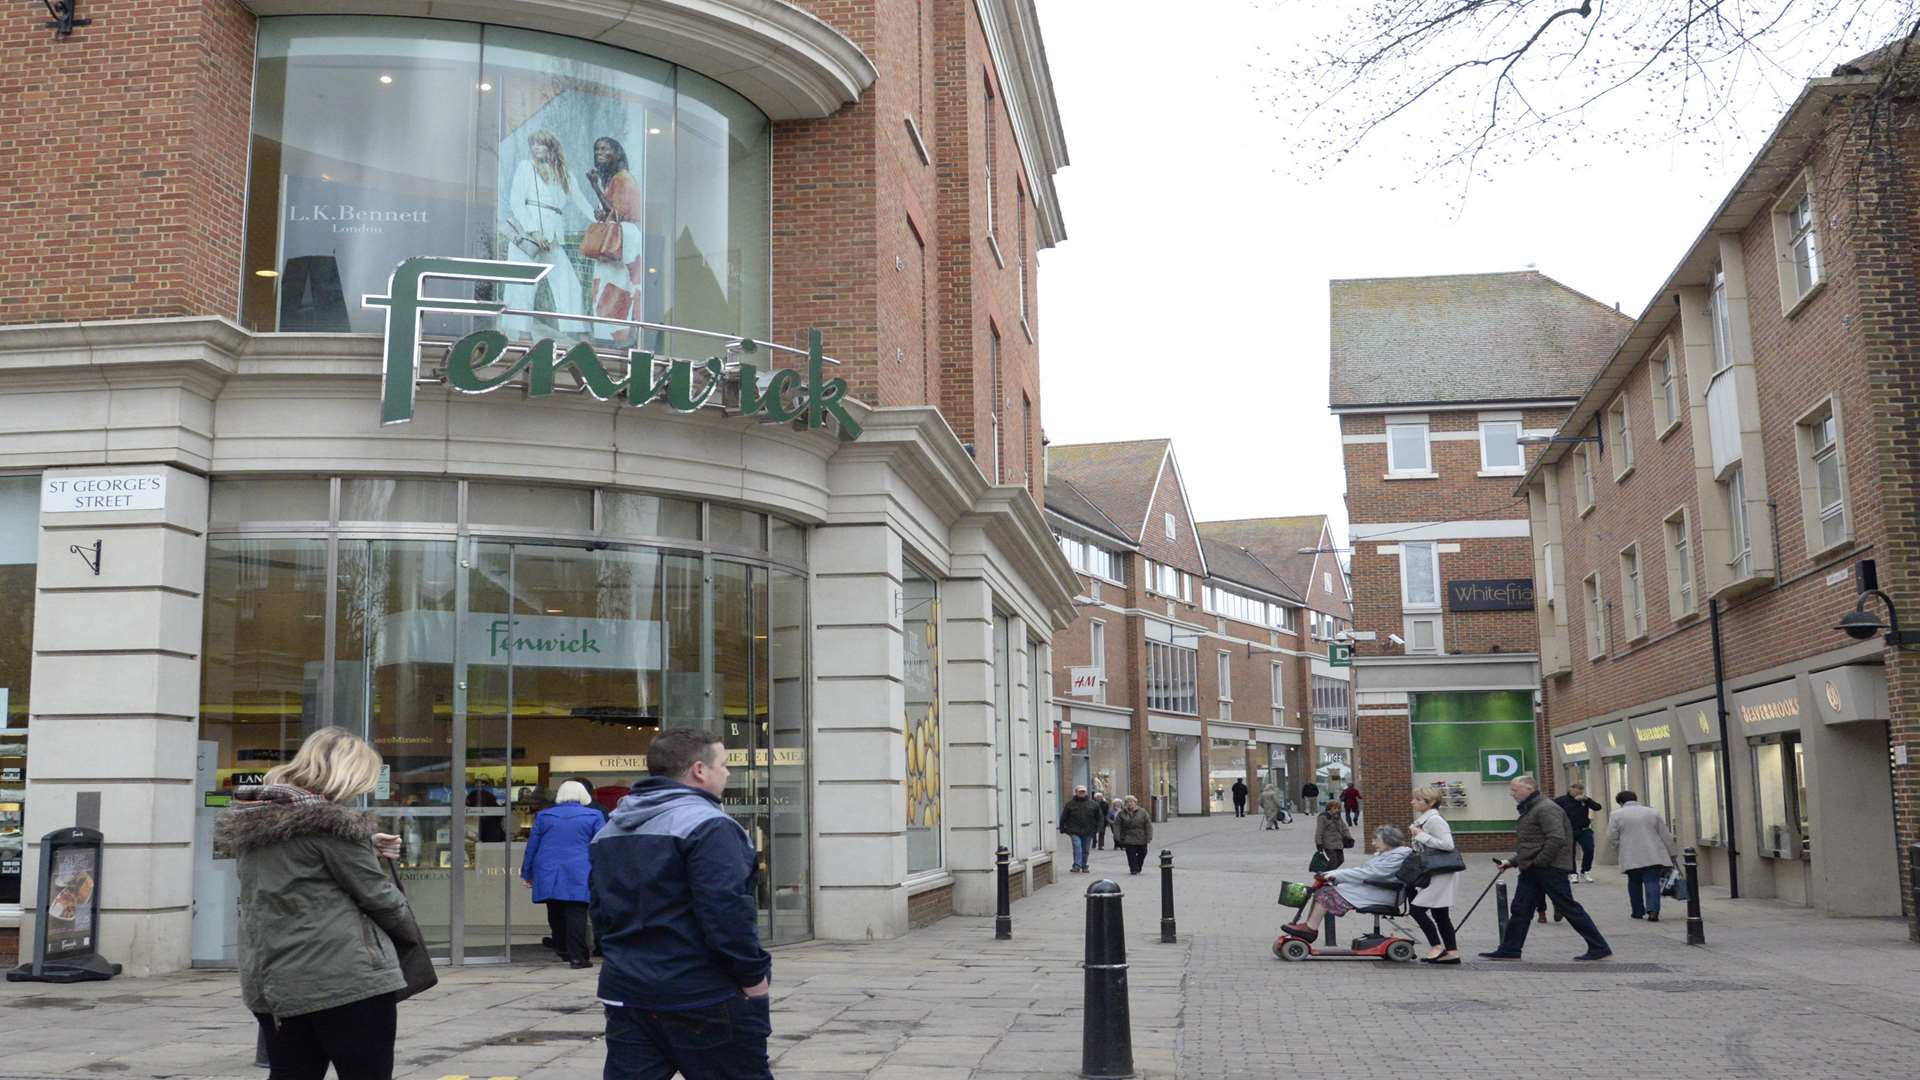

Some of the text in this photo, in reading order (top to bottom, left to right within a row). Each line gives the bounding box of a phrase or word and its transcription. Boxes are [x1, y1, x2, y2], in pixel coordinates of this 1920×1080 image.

[289, 204, 429, 223] L.K.Bennett
[332, 223, 383, 233] London
[361, 256, 864, 442] Fenwick
[49, 477, 161, 494] ST GEORGE'S
[75, 494, 134, 508] STREET
[1487, 754, 1519, 778] D
